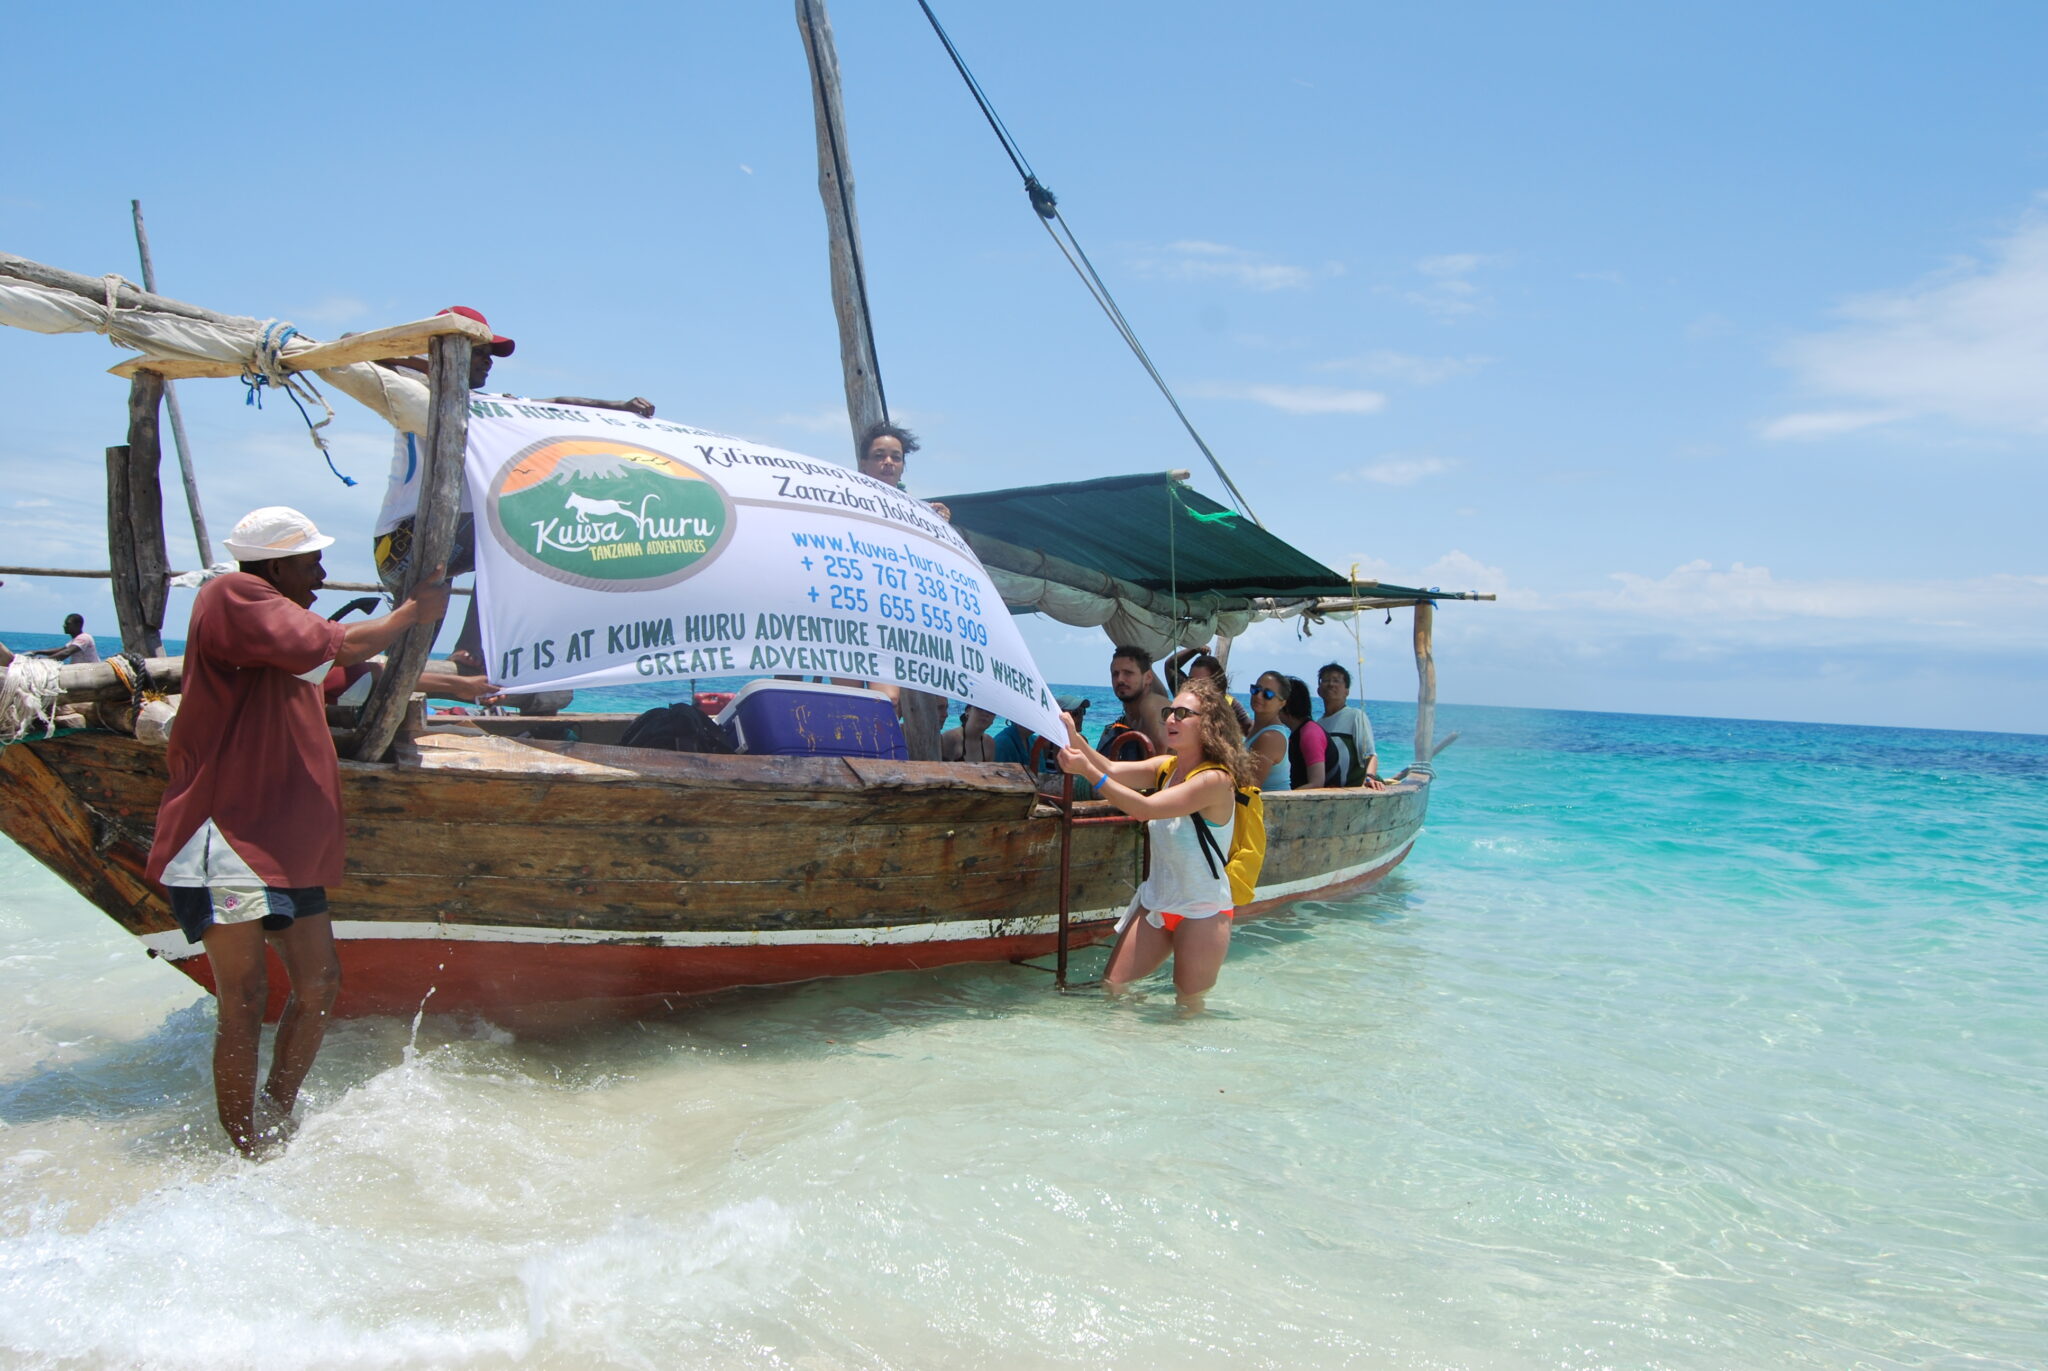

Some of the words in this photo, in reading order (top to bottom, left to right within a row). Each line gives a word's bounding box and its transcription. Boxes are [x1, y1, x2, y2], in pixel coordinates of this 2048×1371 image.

[512, 404, 590, 422] HURU
[694, 445, 842, 479] Kilimanjaro
[772, 475, 877, 513] Zanzibar
[531, 517, 626, 554] Kuwa
[637, 494, 716, 540] huru
[588, 541, 644, 561] TANZANIA
[646, 539, 707, 555] ADVENTURES
[791, 531, 981, 594] www.kuwa-huru.com
[801, 556, 814, 572] +
[824, 555, 864, 582] 255
[872, 563, 908, 591] 767
[915, 573, 948, 603] 338
[951, 585, 982, 616] 733
[807, 586, 820, 603] +
[830, 584, 869, 613] 255
[880, 593, 916, 624] 655
[921, 603, 954, 634] 555
[957, 615, 988, 647] 909
[501, 647, 524, 680] IT
[533, 639, 556, 671] IS
[566, 629, 595, 663] AT
[608, 618, 676, 654] KUWA
[685, 612, 746, 643] HURU
[755, 612, 870, 648] ADVENTURE
[876, 623, 955, 665] TANZANIA
[960, 644, 985, 674] LTD
[990, 656, 1036, 701] WHERE
[1040, 687, 1051, 712] A
[635, 646, 735, 677] GREATE
[749, 645, 879, 677] ADVENTURE
